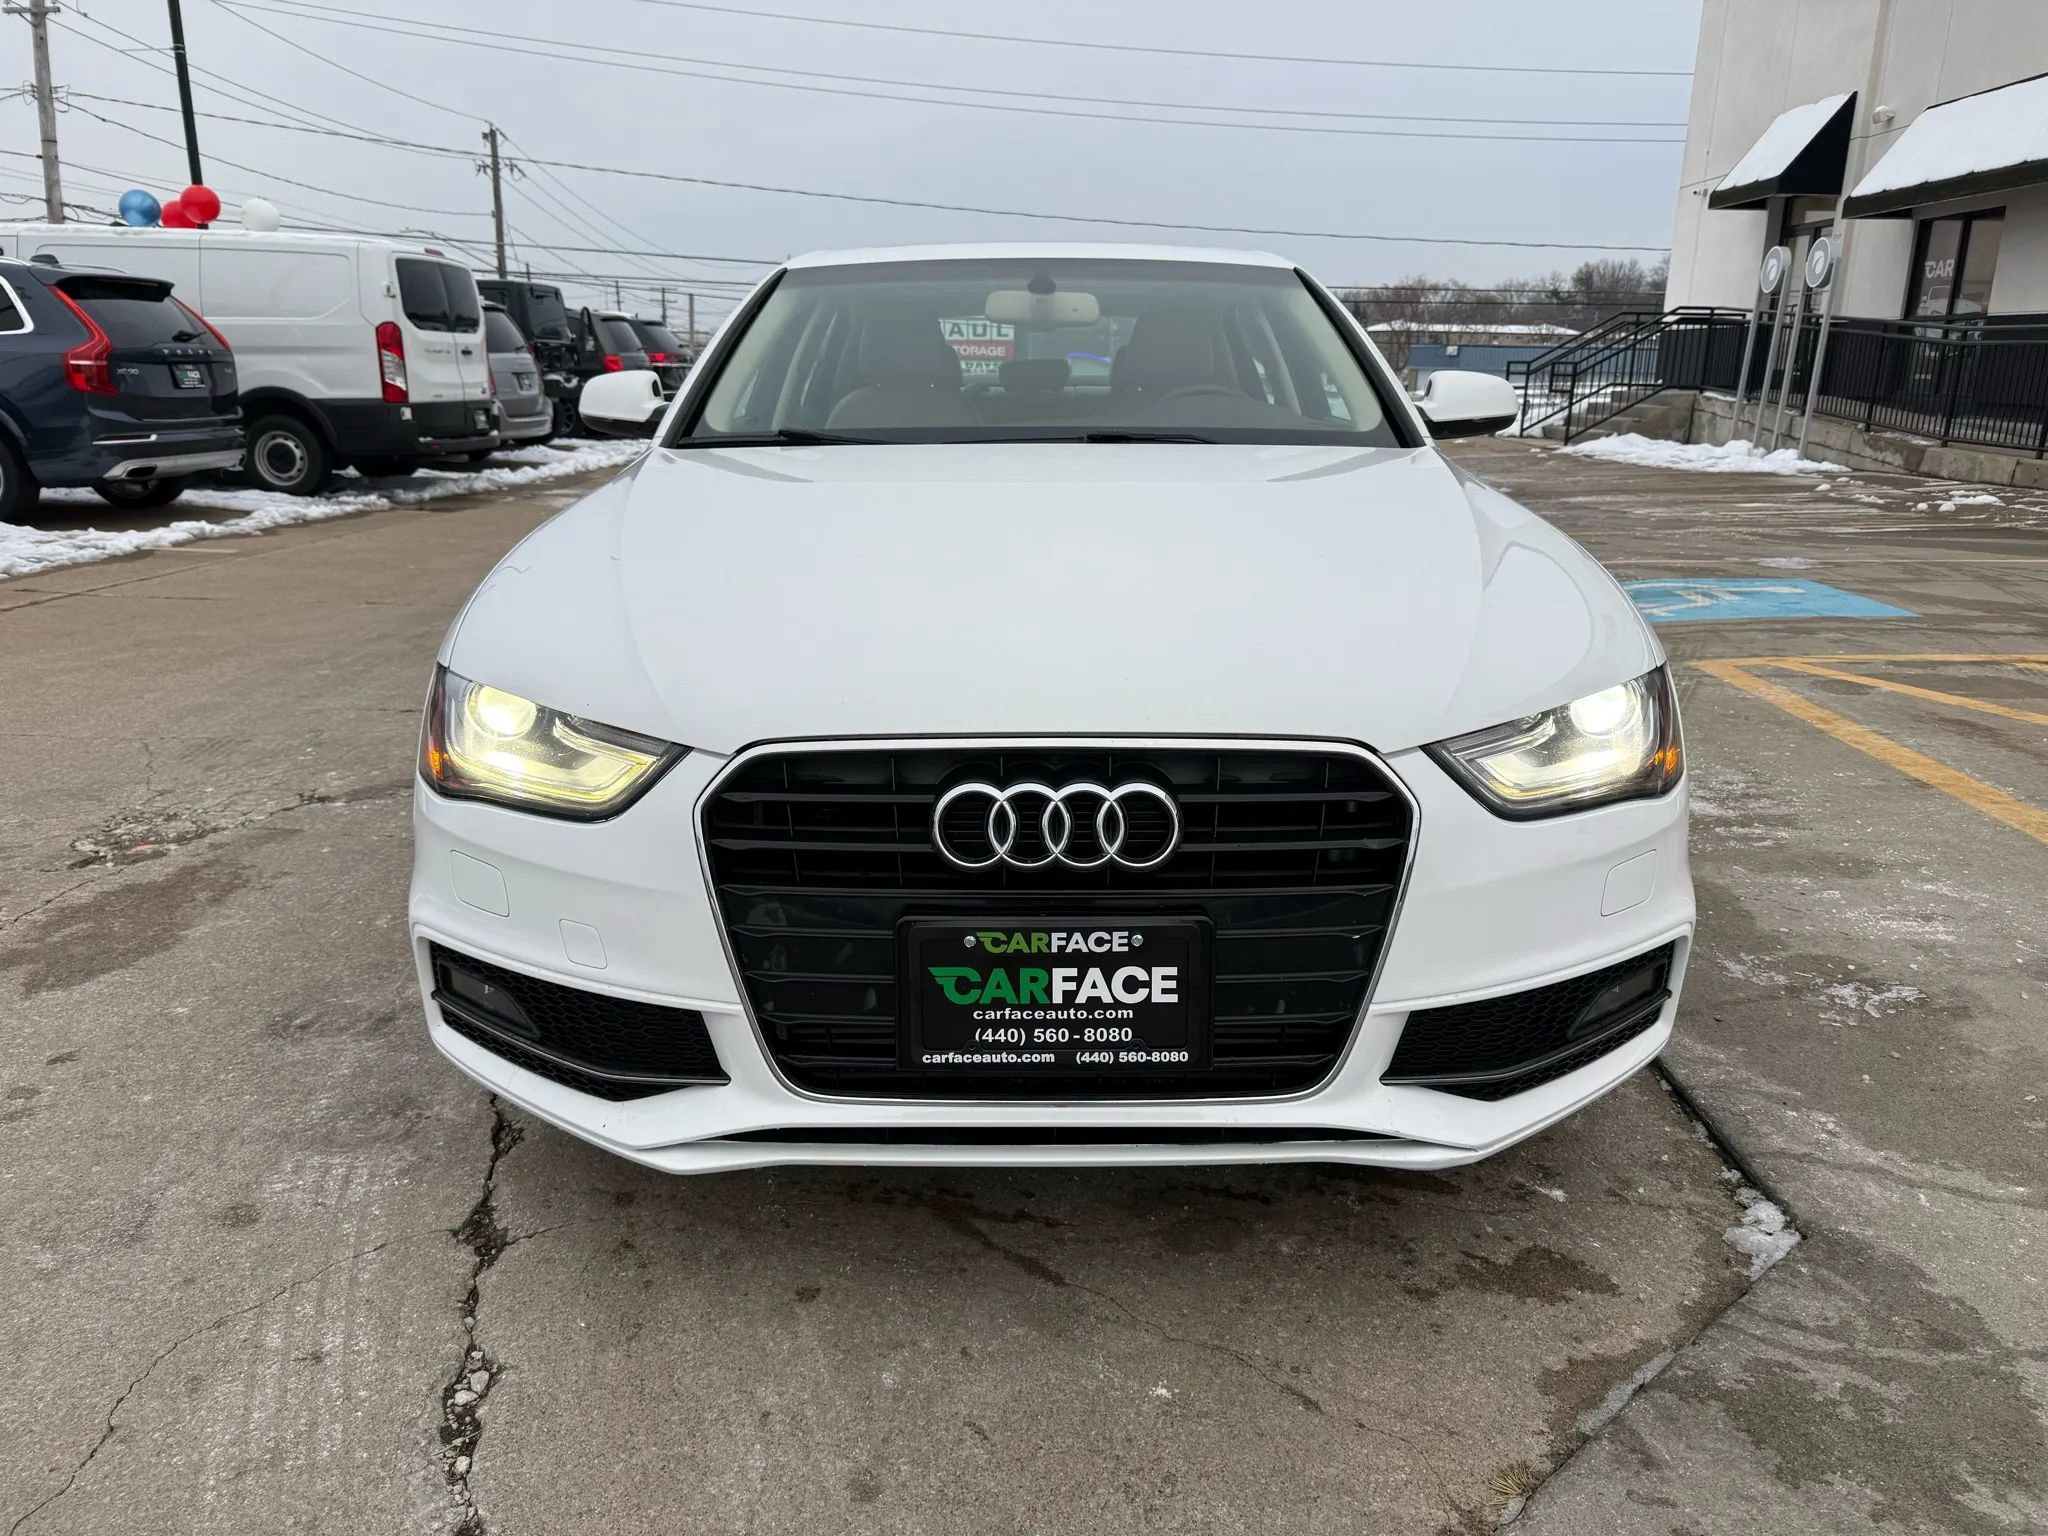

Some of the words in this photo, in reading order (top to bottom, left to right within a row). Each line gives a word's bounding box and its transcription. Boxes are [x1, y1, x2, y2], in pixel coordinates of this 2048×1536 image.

[976, 931, 1129, 953] CARFACE
[928, 966, 1178, 1005] CARFACE
[972, 1008, 1134, 1020] carfaceauto.com
[975, 1028, 1026, 1046] (440)
[922, 1052, 1055, 1065] carfaceauto.com
[1076, 1052, 1115, 1065] (440)
[1118, 1051, 1189, 1064] 560-8080
